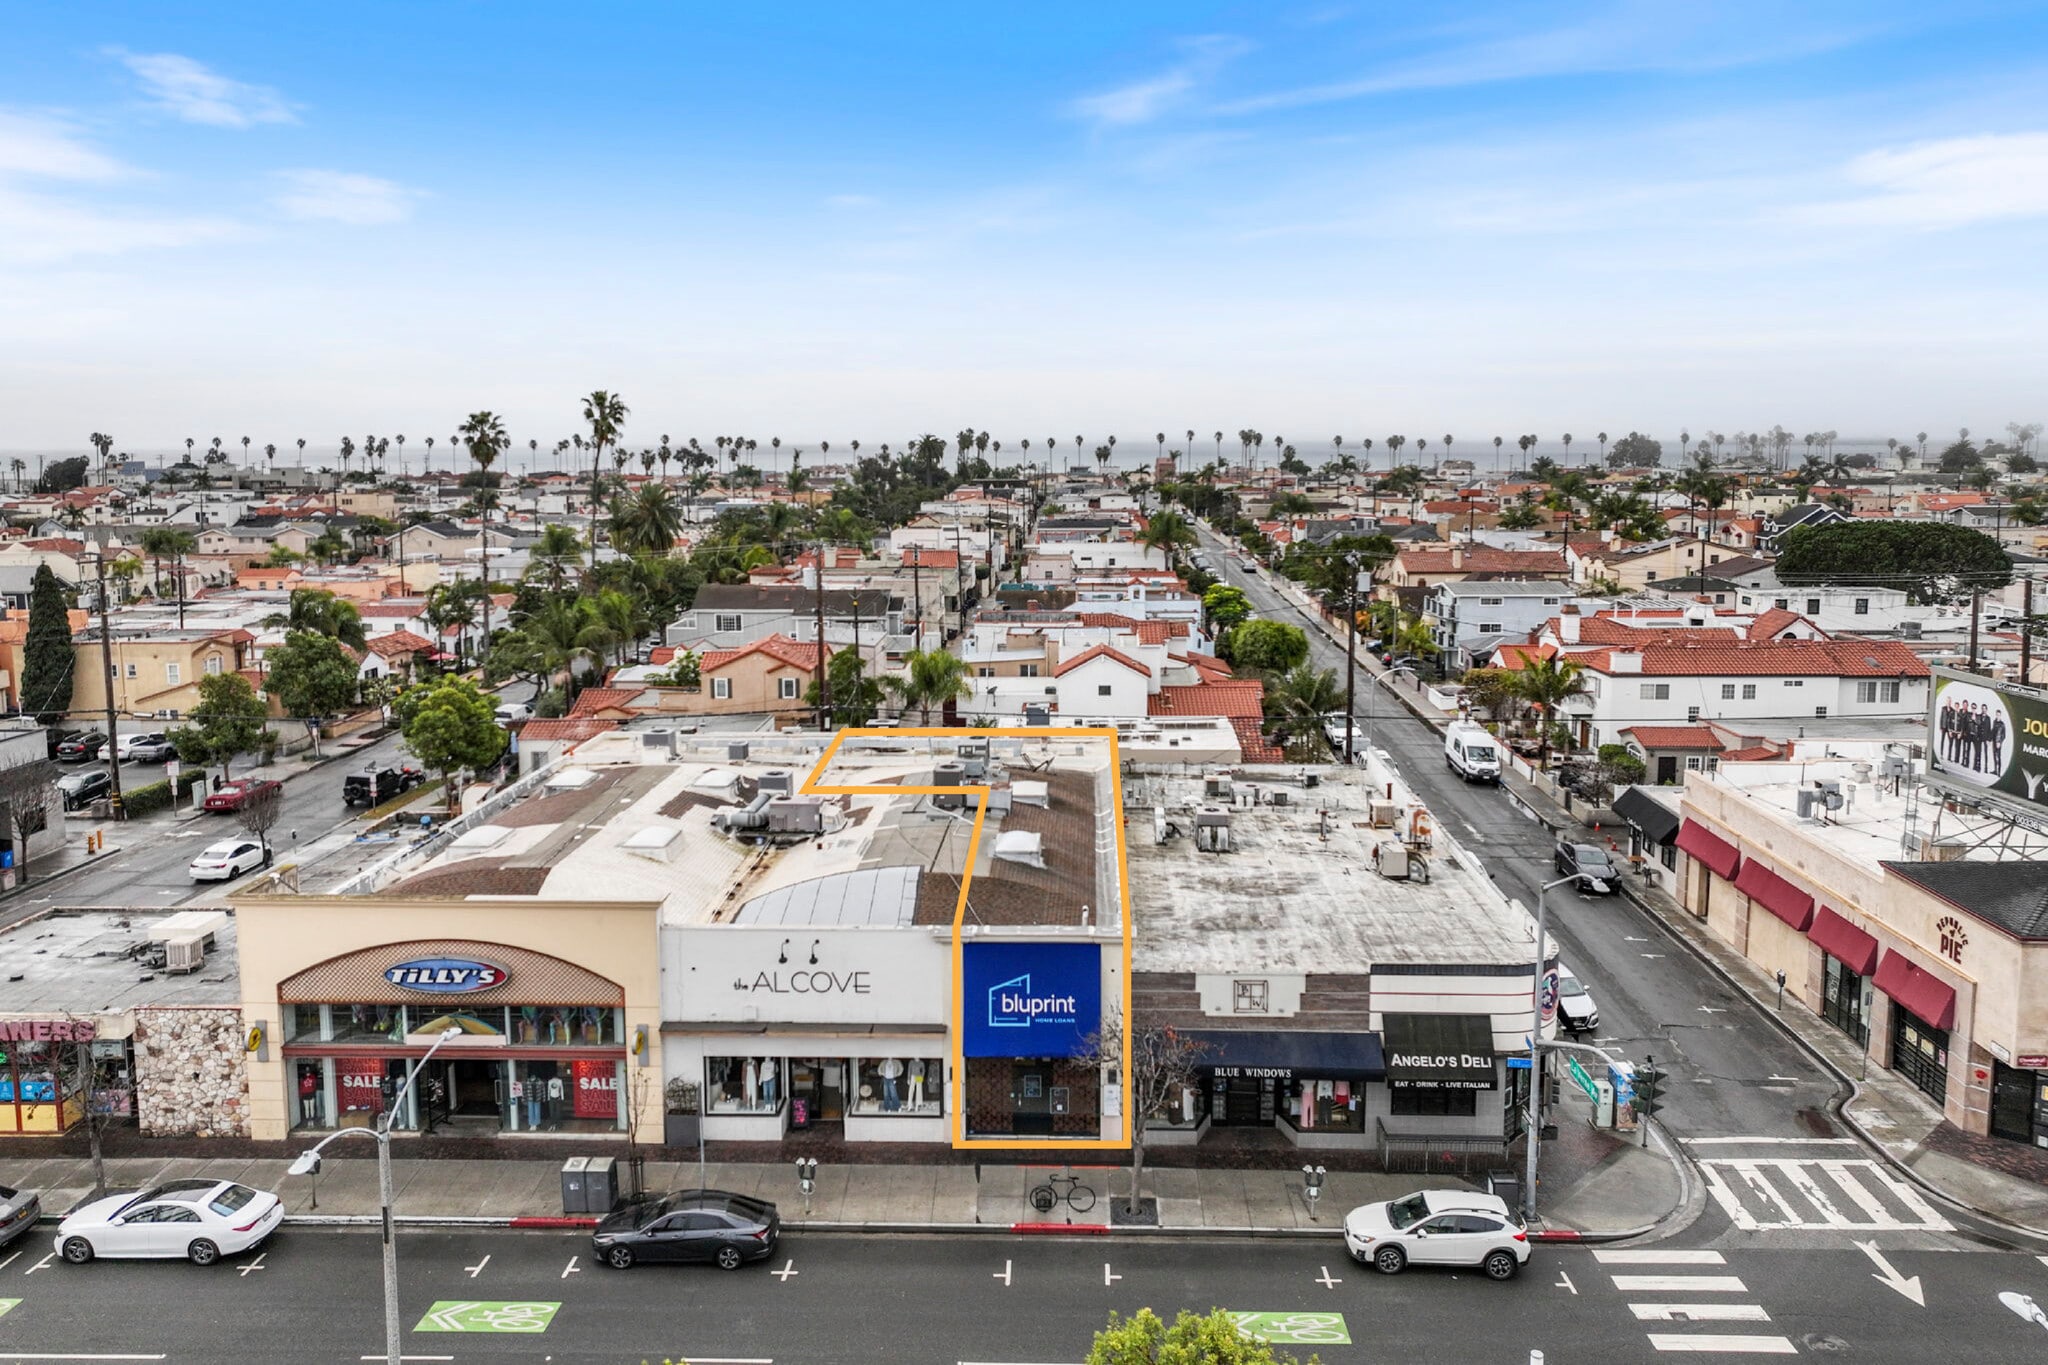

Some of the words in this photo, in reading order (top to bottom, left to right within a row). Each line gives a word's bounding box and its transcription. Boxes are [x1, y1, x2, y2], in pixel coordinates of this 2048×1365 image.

[1940, 933, 1963, 965] PIE
[733, 977, 749, 990] the
[751, 970, 871, 993] ALCOVE
[1002, 993, 1076, 1017] bluprint
[1391, 1053, 1458, 1068] ANGELO'S
[1461, 1054, 1492, 1068] DELI
[1214, 1067, 1240, 1077] BLUE
[1244, 1067, 1292, 1079] WINDOWS
[343, 1075, 381, 1088] SALE
[579, 1077, 618, 1090] SALE
